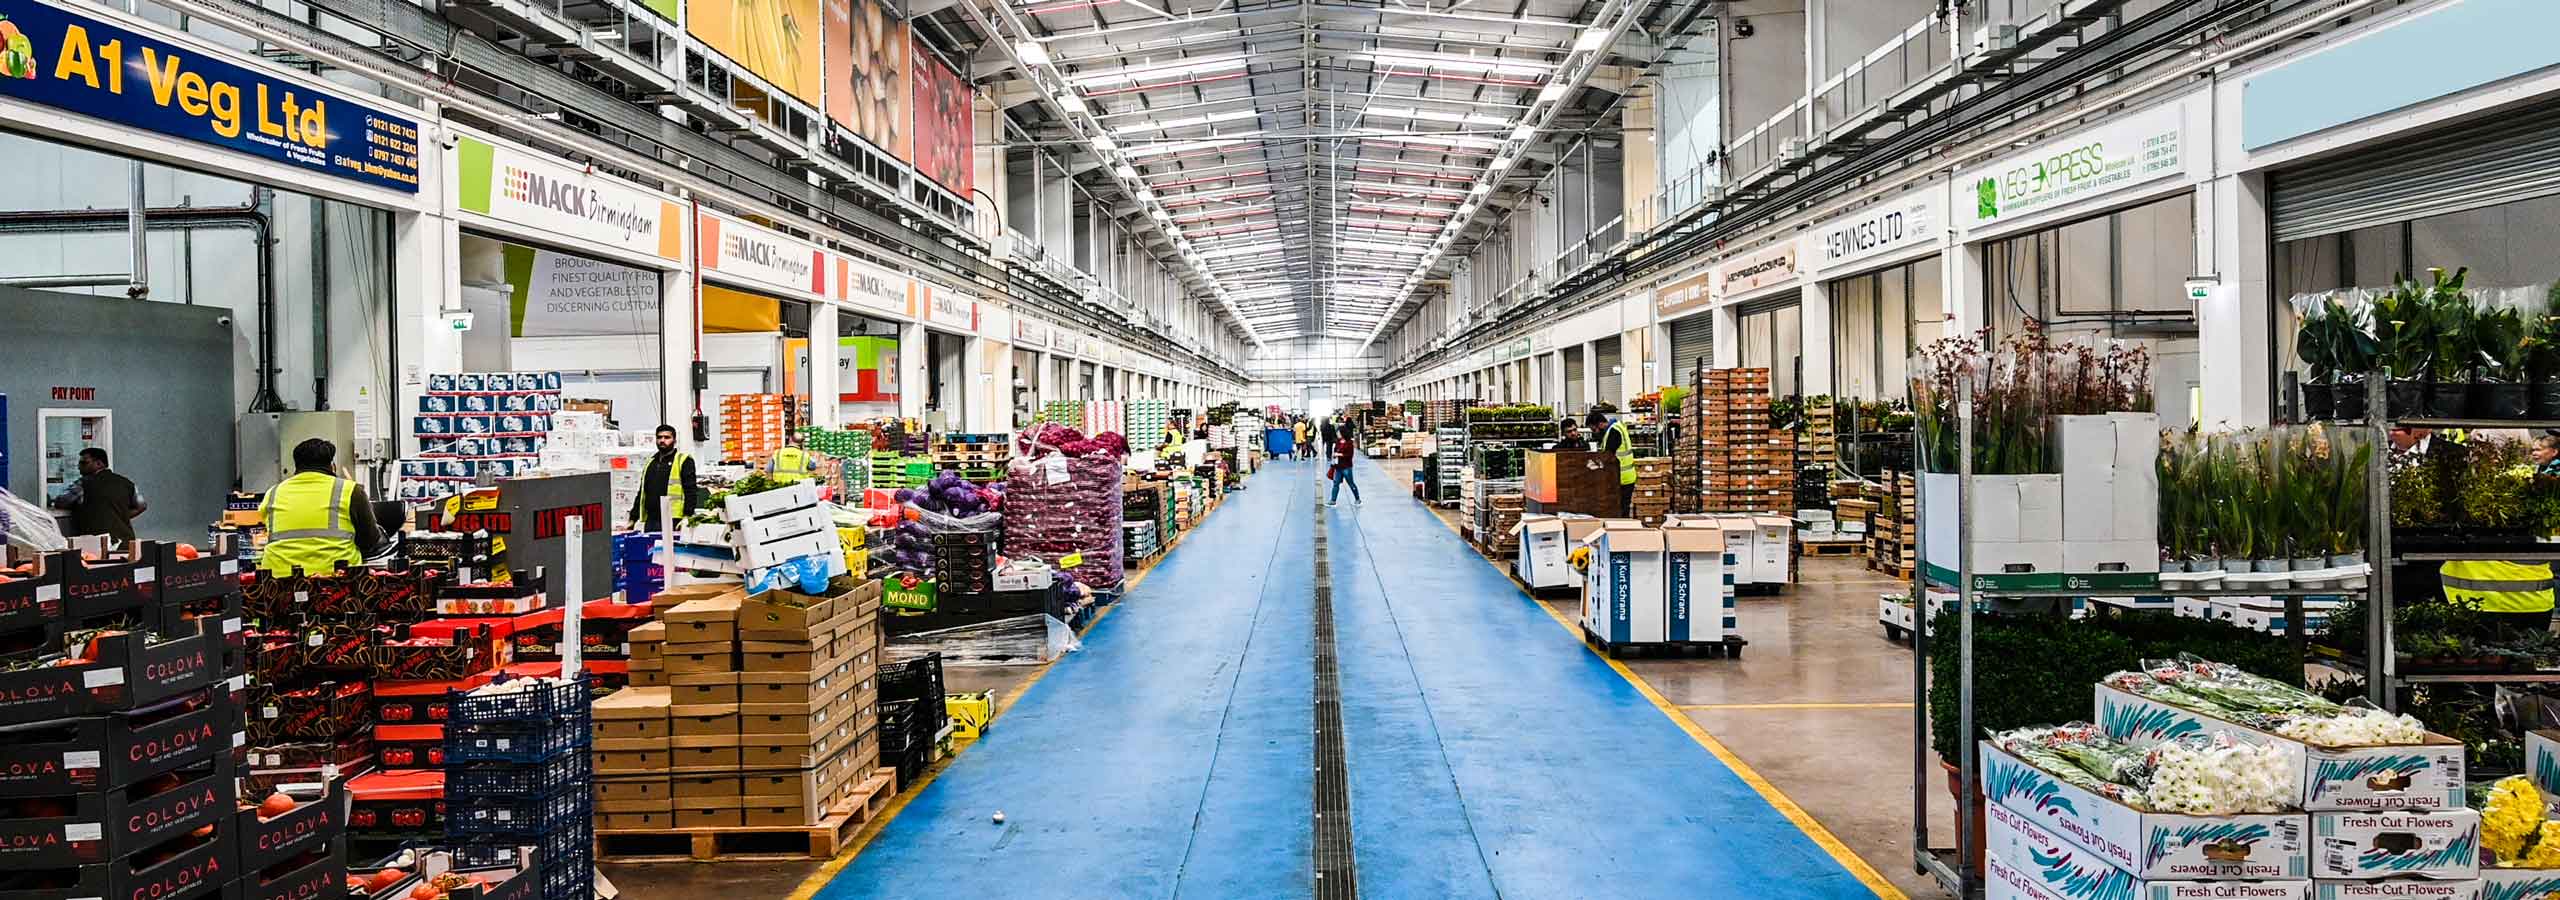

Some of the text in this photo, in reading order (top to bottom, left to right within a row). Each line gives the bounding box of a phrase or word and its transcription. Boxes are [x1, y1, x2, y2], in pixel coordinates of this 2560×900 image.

[54, 23, 327, 149] A1 Veg Ltd
[373, 118, 388, 131] 0121
[291, 144, 308, 155] Fresh
[373, 133, 388, 146] 0121
[1999, 167, 2028, 201] VEG
[2032, 142, 2103, 194] EXPRESS
[528, 173, 652, 241] MACK Birmingham
[1826, 220, 1876, 261] NEWNES
[1880, 211, 1903, 244] LTD
[739, 237, 770, 266] MACK
[552, 272, 586, 283] FINEST
[588, 271, 633, 282] QUALITY
[859, 273, 880, 296] MACK
[550, 285, 654, 297] AND VEGETABLES TO
[546, 301, 657, 313] DISCERNING CUSTOM
[52, 387, 96, 401] PAY POINT
[69, 577, 129, 597] COLOVA
[164, 570, 216, 587] COLOVA
[888, 591, 928, 606] MOND
[1619, 565, 1627, 620] Kurt Schrama
[1679, 564, 1687, 619] Kurt Schrama
[146, 650, 205, 680] COLOVA
[0, 681, 75, 701] OLOVA
[130, 723, 214, 761] COLOVA
[129, 788, 216, 832] COLOVA
[2336, 796, 2440, 808] Fresh Cut Flowers
[260, 811, 329, 849] COLOVA
[1990, 803, 2049, 847] Fresh Cut Flowers
[2343, 816, 2454, 829] Fresh Cut Flowers
[2059, 816, 2132, 867] Fresh Cut Flowers
[133, 856, 220, 900] COLOVA
[1990, 859, 2009, 880] Fresh
[2009, 871, 2021, 889] Cut
[2171, 865, 2281, 876] Fresh Cut Flowers
[2177, 885, 2288, 897] Fresh Cut Flowers
[2344, 884, 2456, 896] Fresh Cut Flowers
